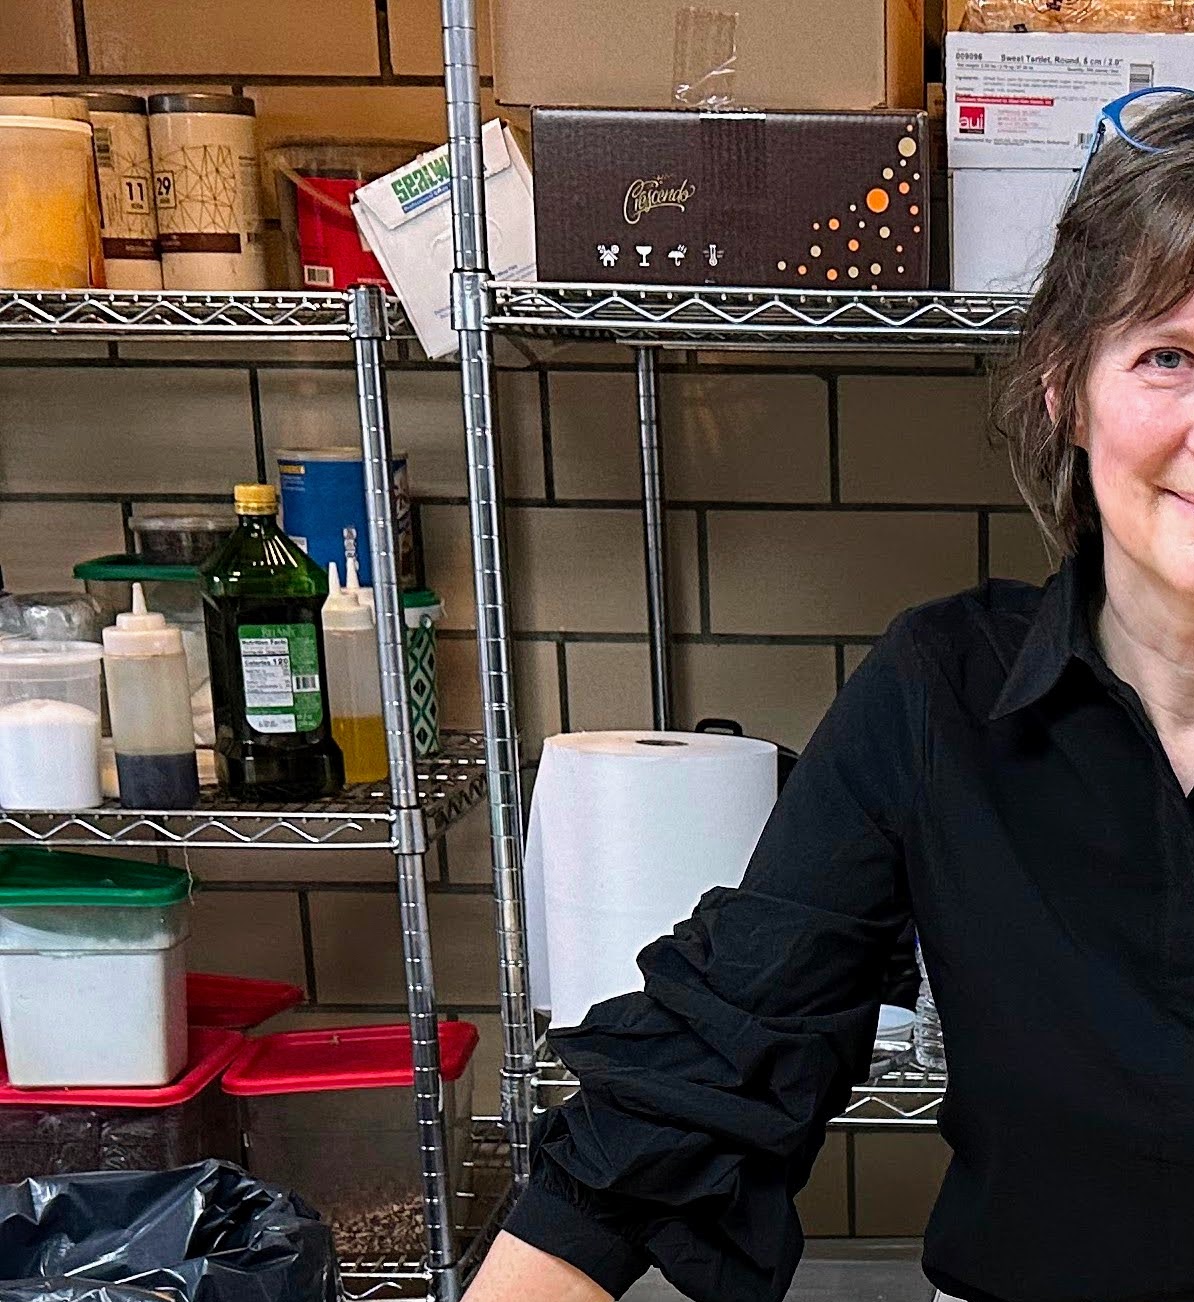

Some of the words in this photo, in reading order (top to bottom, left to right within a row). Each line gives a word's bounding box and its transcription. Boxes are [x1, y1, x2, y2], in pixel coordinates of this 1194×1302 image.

[959, 113, 985, 131] aui
[125, 181, 144, 202] 11
[156, 176, 172, 196] 29
[623, 178, 697, 225] Crescendo
